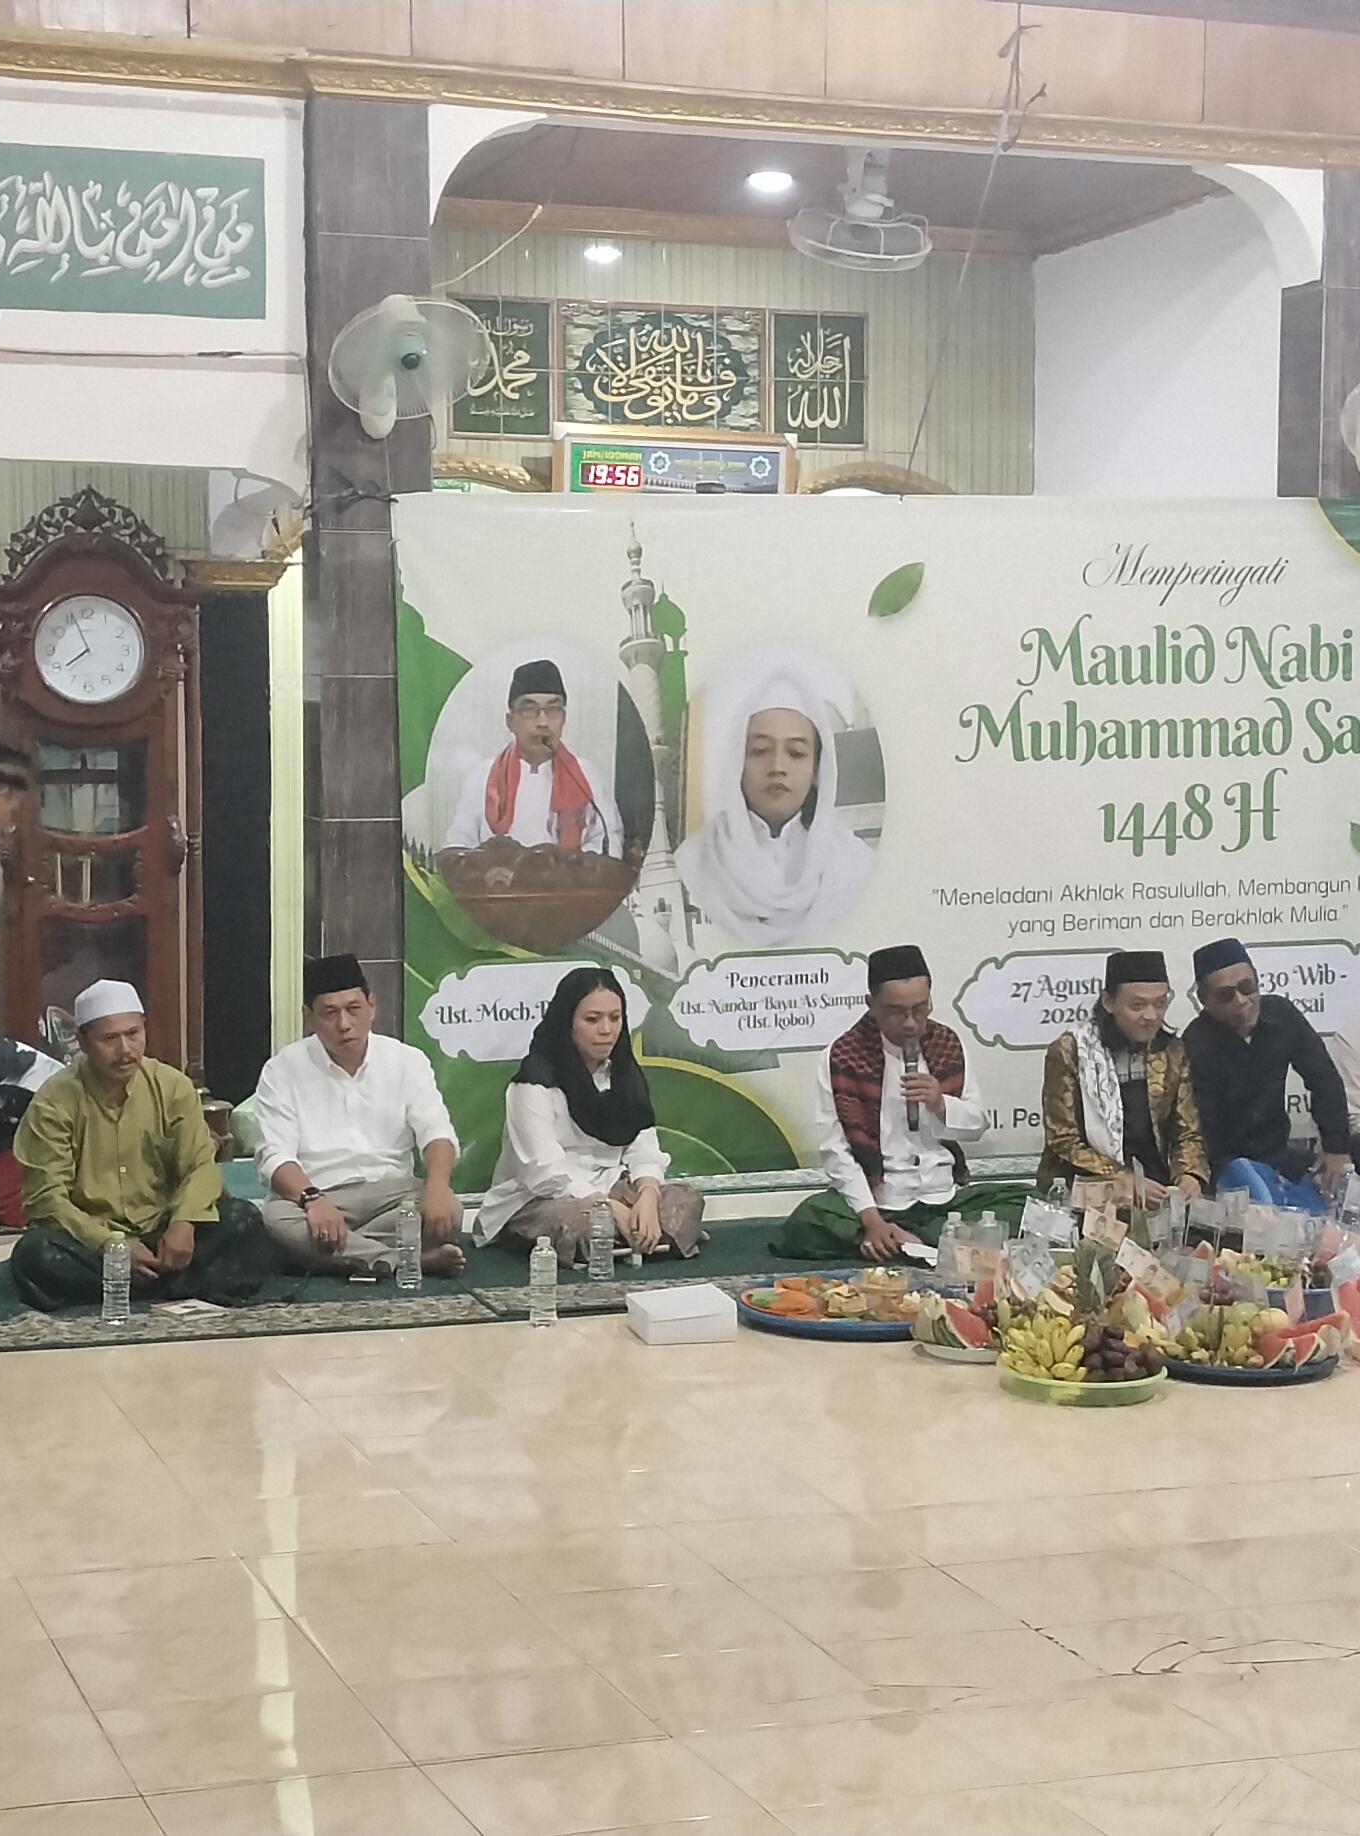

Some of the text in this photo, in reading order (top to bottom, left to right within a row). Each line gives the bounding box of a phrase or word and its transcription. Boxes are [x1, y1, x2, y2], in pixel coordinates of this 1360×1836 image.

[589, 464, 640, 486] 19:56
[1082, 543, 1290, 607] Memperingati
[1016, 613, 1354, 690] Maulid Nabi
[954, 689, 1294, 766] Muhammad
[1098, 767, 1288, 857] 1448 H
[1060, 883, 1125, 902] Akhlak
[1132, 879, 1231, 901] Rasulullah,
[1238, 877, 1351, 898] Membangun
[1007, 917, 1055, 938] yang
[1063, 912, 1142, 932] Beriman
[1149, 911, 1184, 928] dan
[1191, 906, 1284, 927] Berakhlak
[725, 967, 829, 989] Penceramah
[1259, 972, 1290, 993] :30
[1293, 962, 1336, 986] Wib
[677, 1001, 705, 1015] Ust.
[820, 993, 865, 1010] Sampu
[1010, 981, 1033, 1003] 27
[435, 1005, 472, 1025] Ust.
[1039, 1002, 1089, 1025] 2026
[1013, 1107, 1041, 1129] Pe
